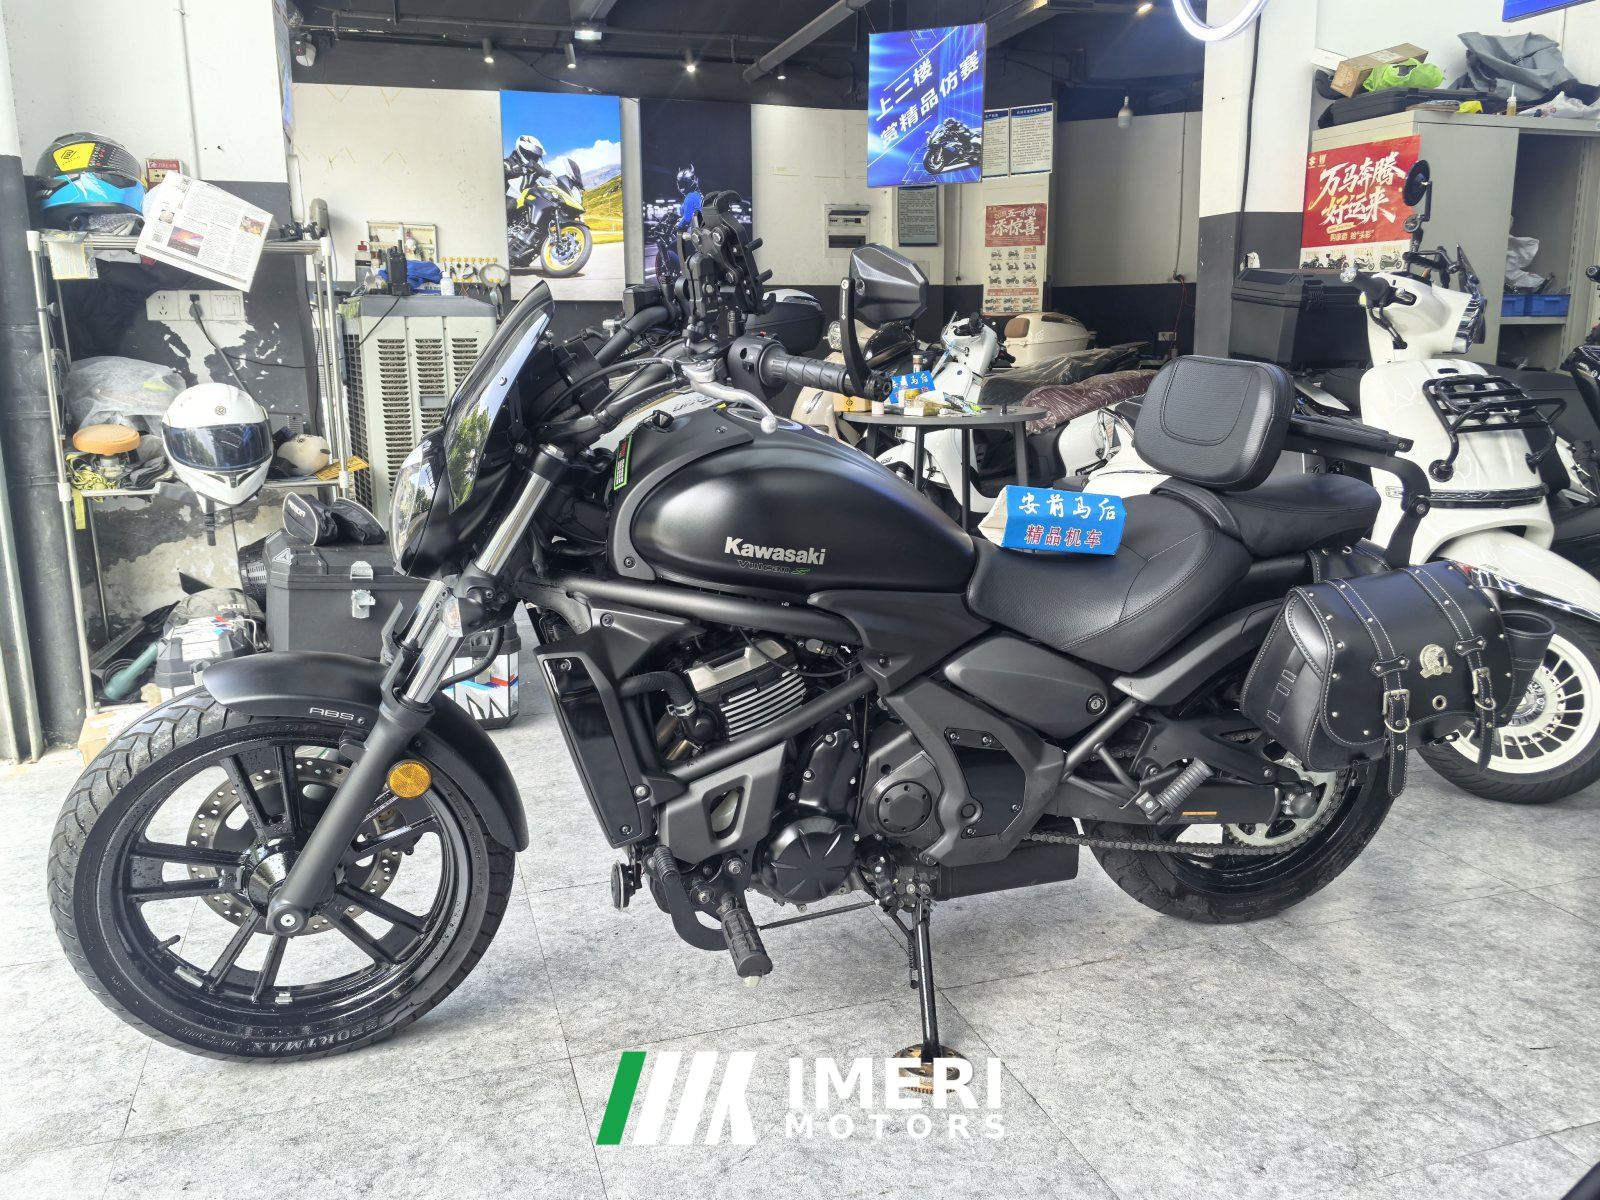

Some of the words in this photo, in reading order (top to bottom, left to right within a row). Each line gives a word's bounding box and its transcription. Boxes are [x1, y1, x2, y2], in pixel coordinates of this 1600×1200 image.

[876, 57, 933, 122] 上二楼
[880, 50, 980, 149] 赏精品仿赛
[1307, 151, 1407, 211] 万马奔腾
[1319, 185, 1396, 225] 好运来
[991, 216, 1040, 236] 添惊喜
[1018, 492, 1116, 522] 安前马后
[724, 536, 826, 565] Kawasaki
[1023, 523, 1103, 549] 精品机车
[309, 707, 355, 721] ABS
